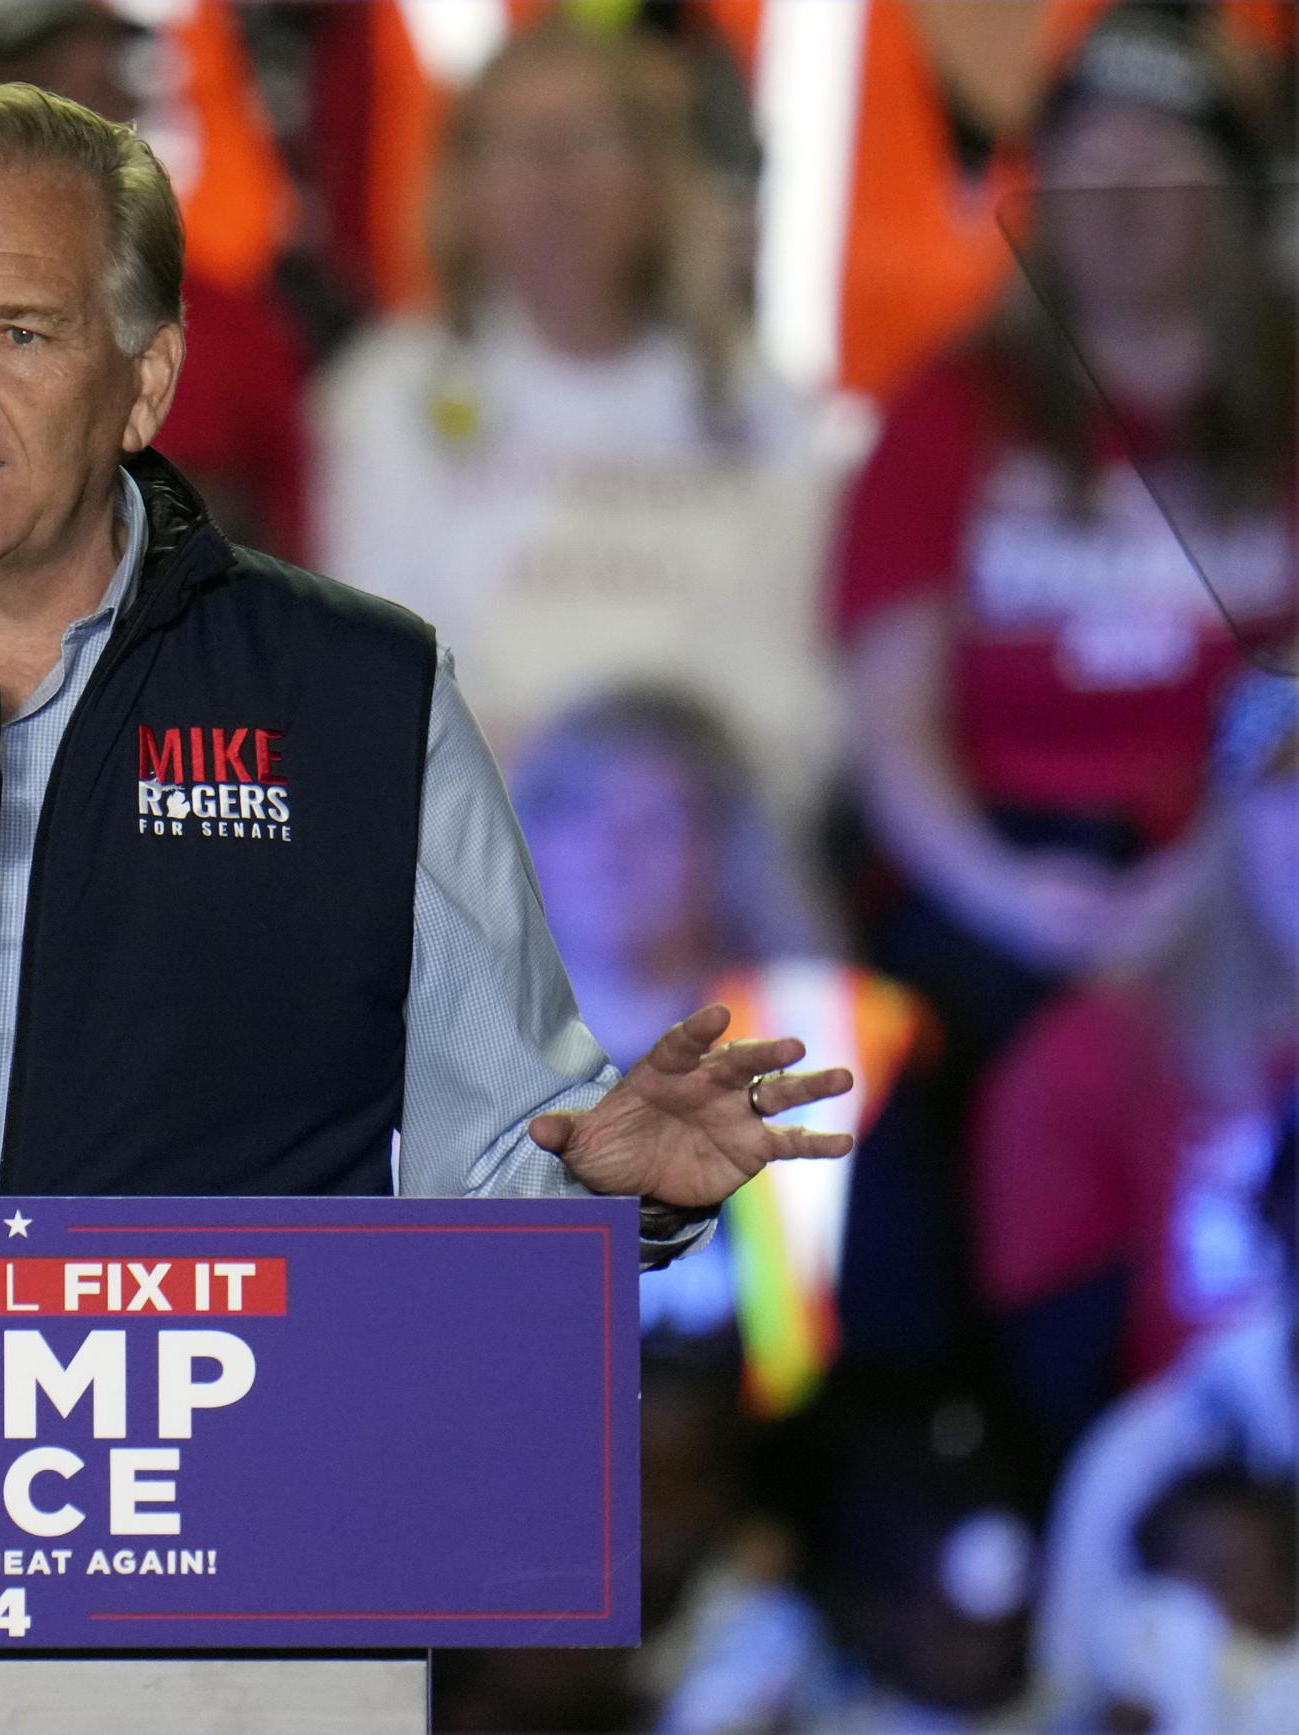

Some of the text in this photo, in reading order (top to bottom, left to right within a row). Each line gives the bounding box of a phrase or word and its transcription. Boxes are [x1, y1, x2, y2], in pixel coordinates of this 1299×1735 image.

[138, 724, 290, 786] MIKE
[138, 818, 293, 842] FOR SENATE
[64, 1262, 173, 1312] FIX
[195, 1262, 257, 1312] IT
[86, 1549, 217, 1575] AGAIN!
